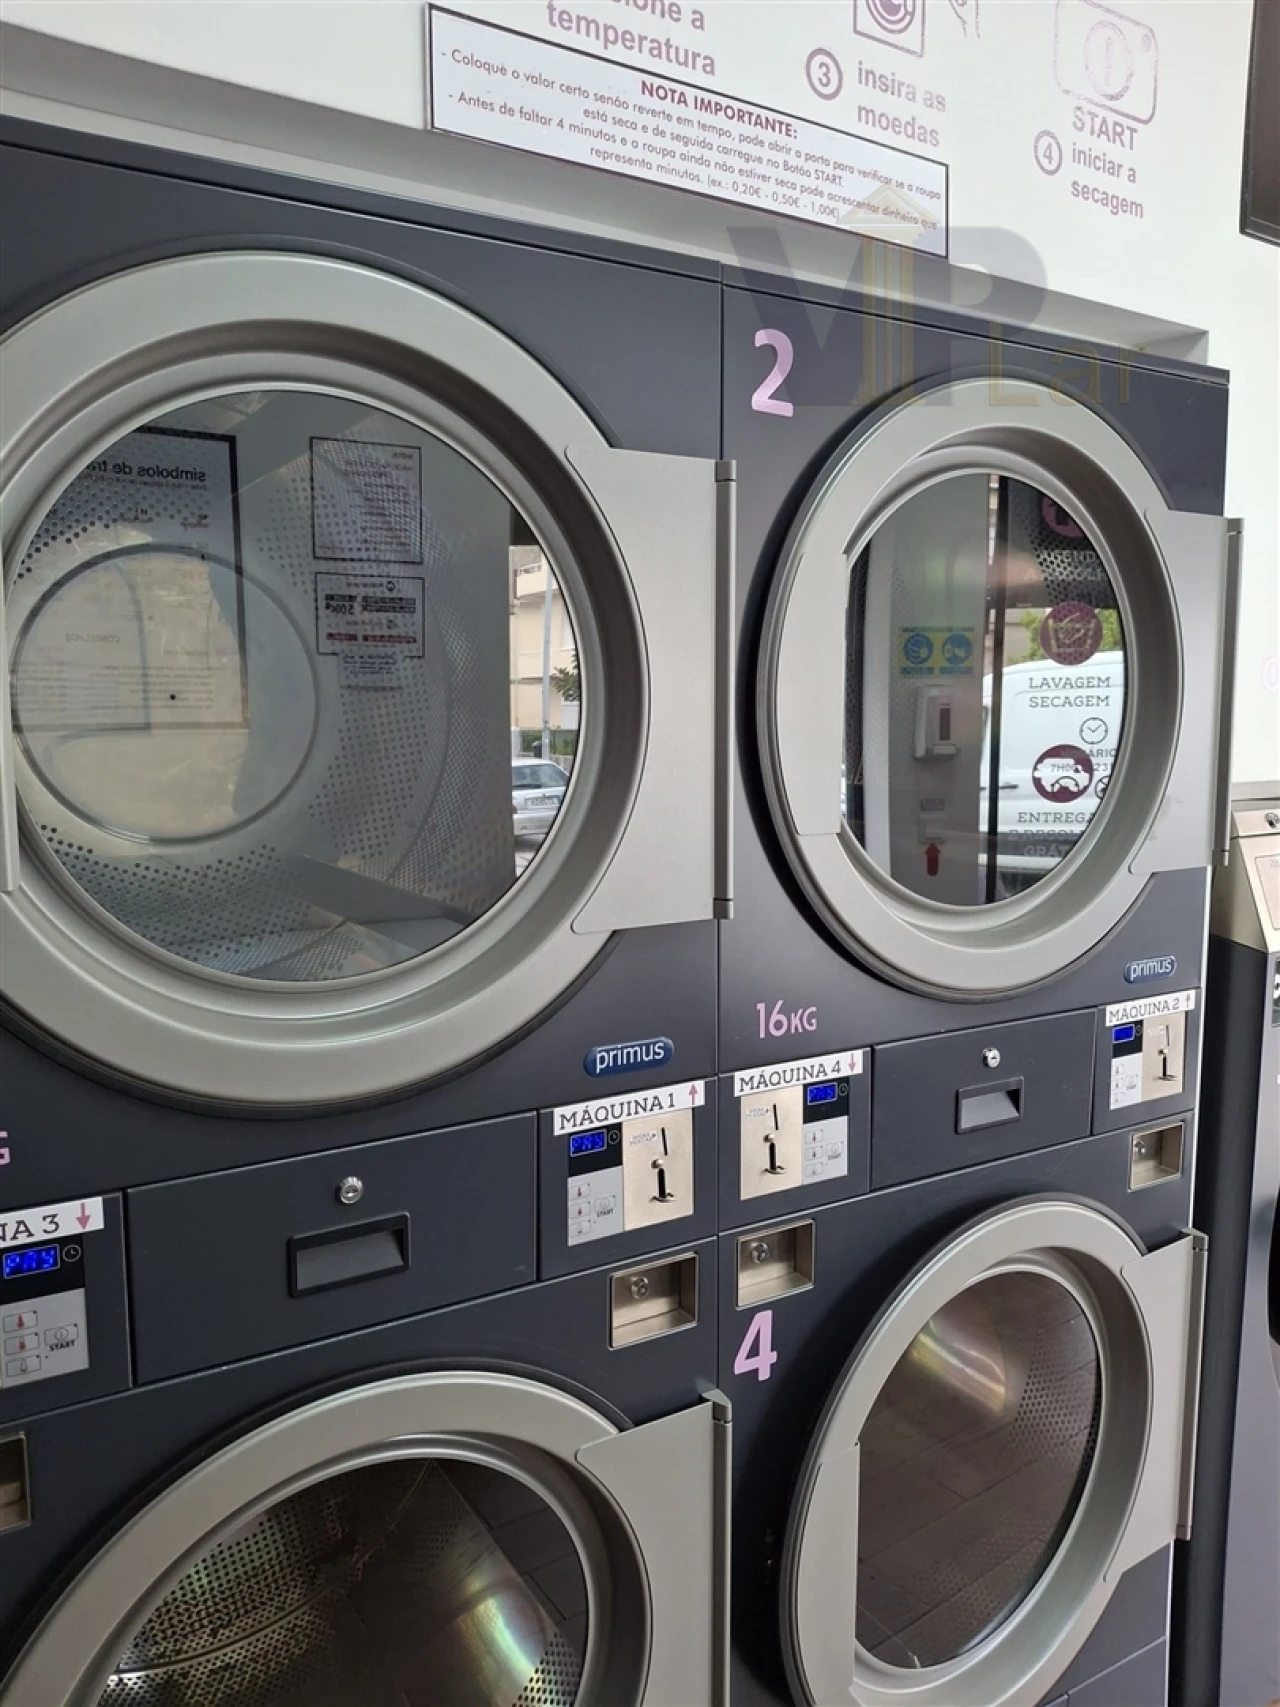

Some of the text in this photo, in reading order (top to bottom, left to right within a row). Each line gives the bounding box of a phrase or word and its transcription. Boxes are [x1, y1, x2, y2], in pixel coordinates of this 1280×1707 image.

[547, 3, 715, 76] temperatura
[691, 9, 705, 31] a
[818, 62, 831, 88] 3
[858, 60, 946, 112] insira as
[451, 49, 508, 76] Coloque
[512, 69, 520, 80] o
[524, 73, 555, 89] valor
[559, 83, 590, 99] certo
[633, 103, 673, 123] reverte
[676, 117, 694, 128] em
[697, 120, 735, 141] tempo,
[738, 133, 765, 149] pode
[768, 140, 793, 156] abrir
[795, 150, 801, 159] a
[804, 152, 830, 167] porta
[833, 161, 855, 175] para
[857, 168, 893, 187] verificar
[896, 180, 905, 189] se
[907, 184, 913, 192] a
[915, 186, 941, 201] roupa
[641, 80, 798, 140] NOTA IMPORTANTE:
[858, 105, 939, 147] moedas
[1072, 106, 1138, 151] START
[458, 91, 495, 112] Antes
[499, 101, 515, 118] de
[520, 106, 553, 126] faltar
[556, 118, 564, 129] 4
[569, 121, 617, 143] minutos
[620, 136, 628, 146] e
[631, 139, 639, 149] a
[642, 142, 676, 159] roupa
[679, 150, 711, 167] ainda
[714, 160, 735, 174] não
[738, 167, 772, 184] estiver
[775, 177, 797, 191] seca
[800, 184, 828, 199] pode
[827, 192, 880, 214] acrescentar
[882, 203, 919, 225] dinheiro
[921, 218, 938, 231] que
[583, 108, 608, 123] está
[612, 116, 638, 131] seca
[641, 123, 648, 134] e
[653, 124, 666, 138] de
[670, 130, 713, 151] seguida
[717, 143, 764, 165] carregue
[766, 157, 780, 169] no
[814, 168, 844, 188] START.
[1043, 143, 1053, 164] 4
[1072, 142, 1137, 183] iniciar a
[590, 146, 652, 170] representa
[656, 165, 704, 184] minutos.
[731, 181, 762, 199] 0,20€
[772, 190, 800, 208] 0,50€
[1071, 180, 1144, 219] secagem
[751, 329, 794, 418] 2
[1029, 676, 1111, 689] LAVAGEM
[1029, 695, 1110, 708] SECAGEM
[1130, 959, 1172, 981] primus
[757, 1000, 817, 1039] 16KG
[1108, 997, 1180, 1024] MÁQUINA 2
[596, 1041, 665, 1074] primus
[739, 1060, 841, 1093] MÁQUINA 4
[559, 1092, 676, 1131] MÁQUINA 1
[42, 1213, 60, 1234] 3
[49, 1340, 76, 1352] START
[734, 1310, 778, 1382] 4
